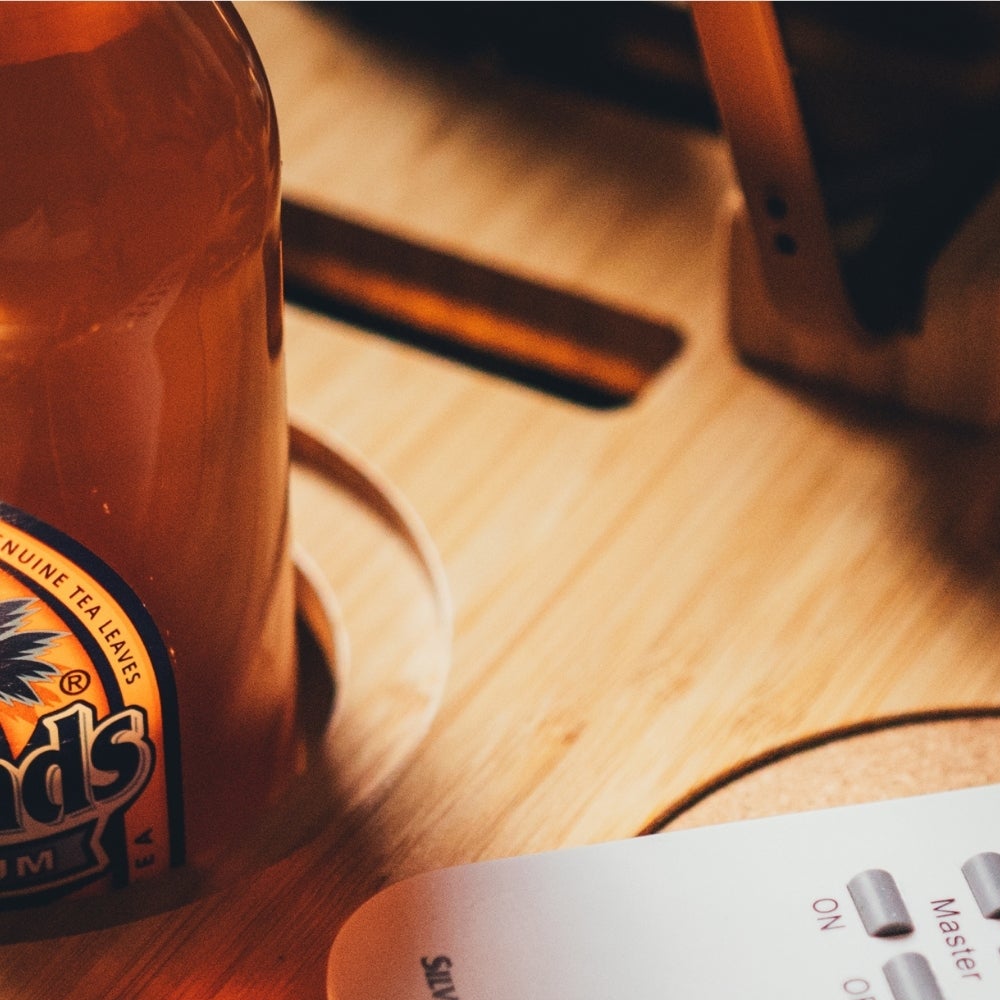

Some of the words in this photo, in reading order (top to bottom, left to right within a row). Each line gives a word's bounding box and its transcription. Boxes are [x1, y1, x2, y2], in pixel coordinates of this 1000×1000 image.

[0, 534, 69, 588] NUINE
[69, 585, 102, 621] TEA
[98, 619, 142, 685] LEAVES
[812, 897, 847, 932] ON
[930, 897, 983, 982] Master
